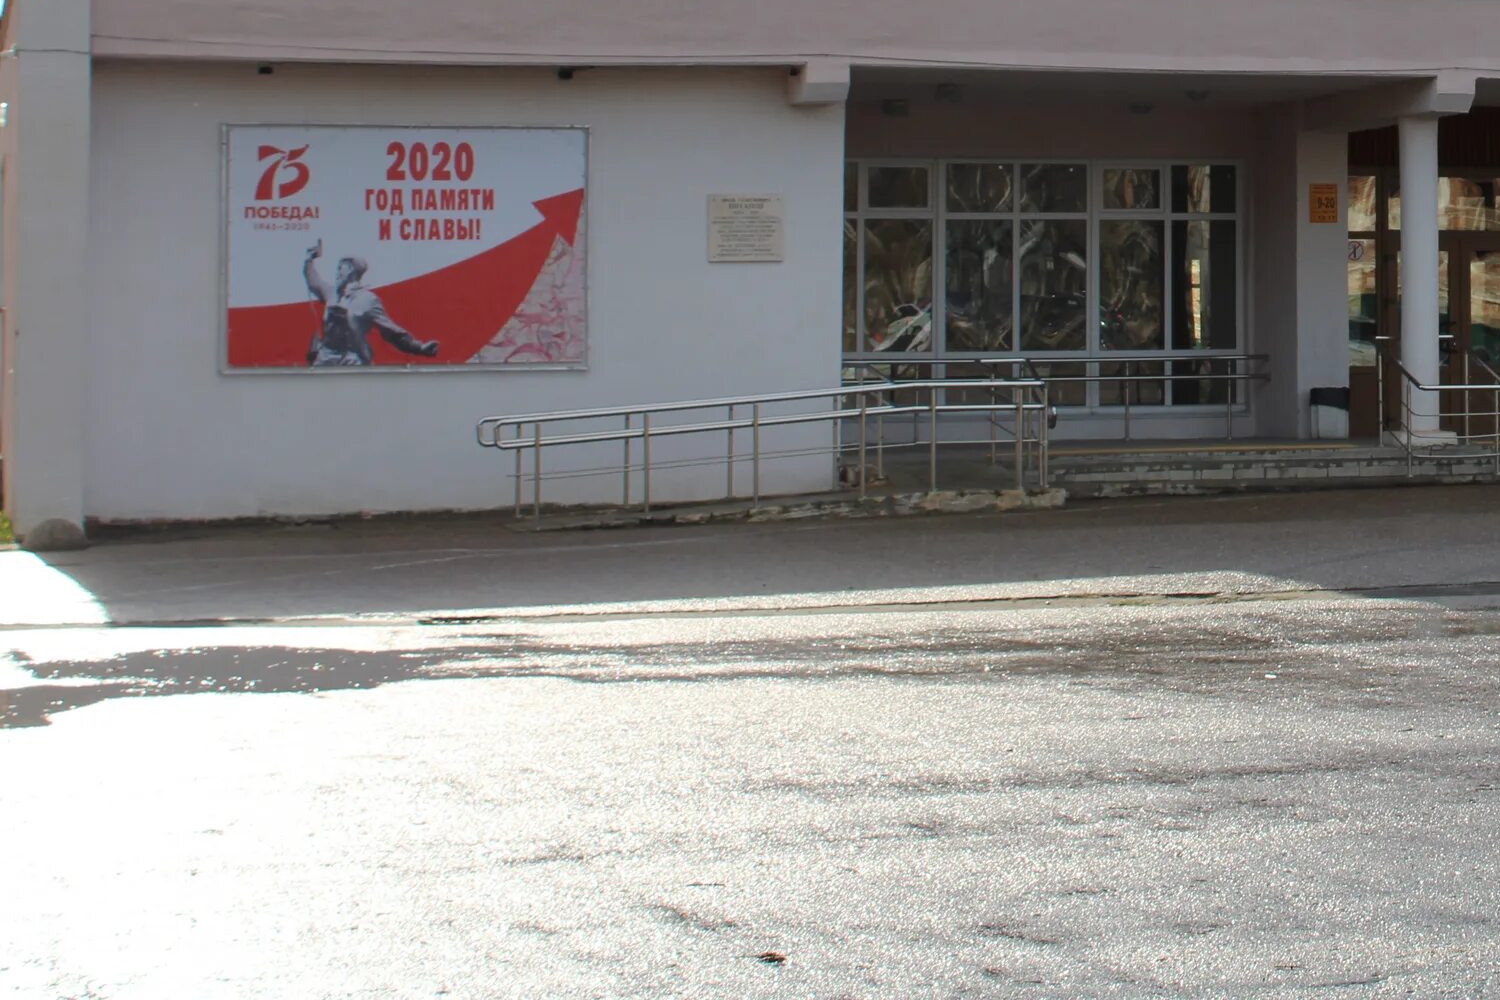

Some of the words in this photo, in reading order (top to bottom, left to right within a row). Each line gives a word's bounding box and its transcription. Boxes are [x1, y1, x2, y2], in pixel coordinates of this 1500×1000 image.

[254, 144, 310, 201] 75
[386, 141, 475, 181] 2020
[244, 206, 320, 221] ПОБЕДА!
[365, 188, 404, 215] ГОД
[411, 188, 495, 211] ПАМЯТИ
[379, 218, 392, 241] И
[399, 218, 481, 241] СЛАВЫ!
